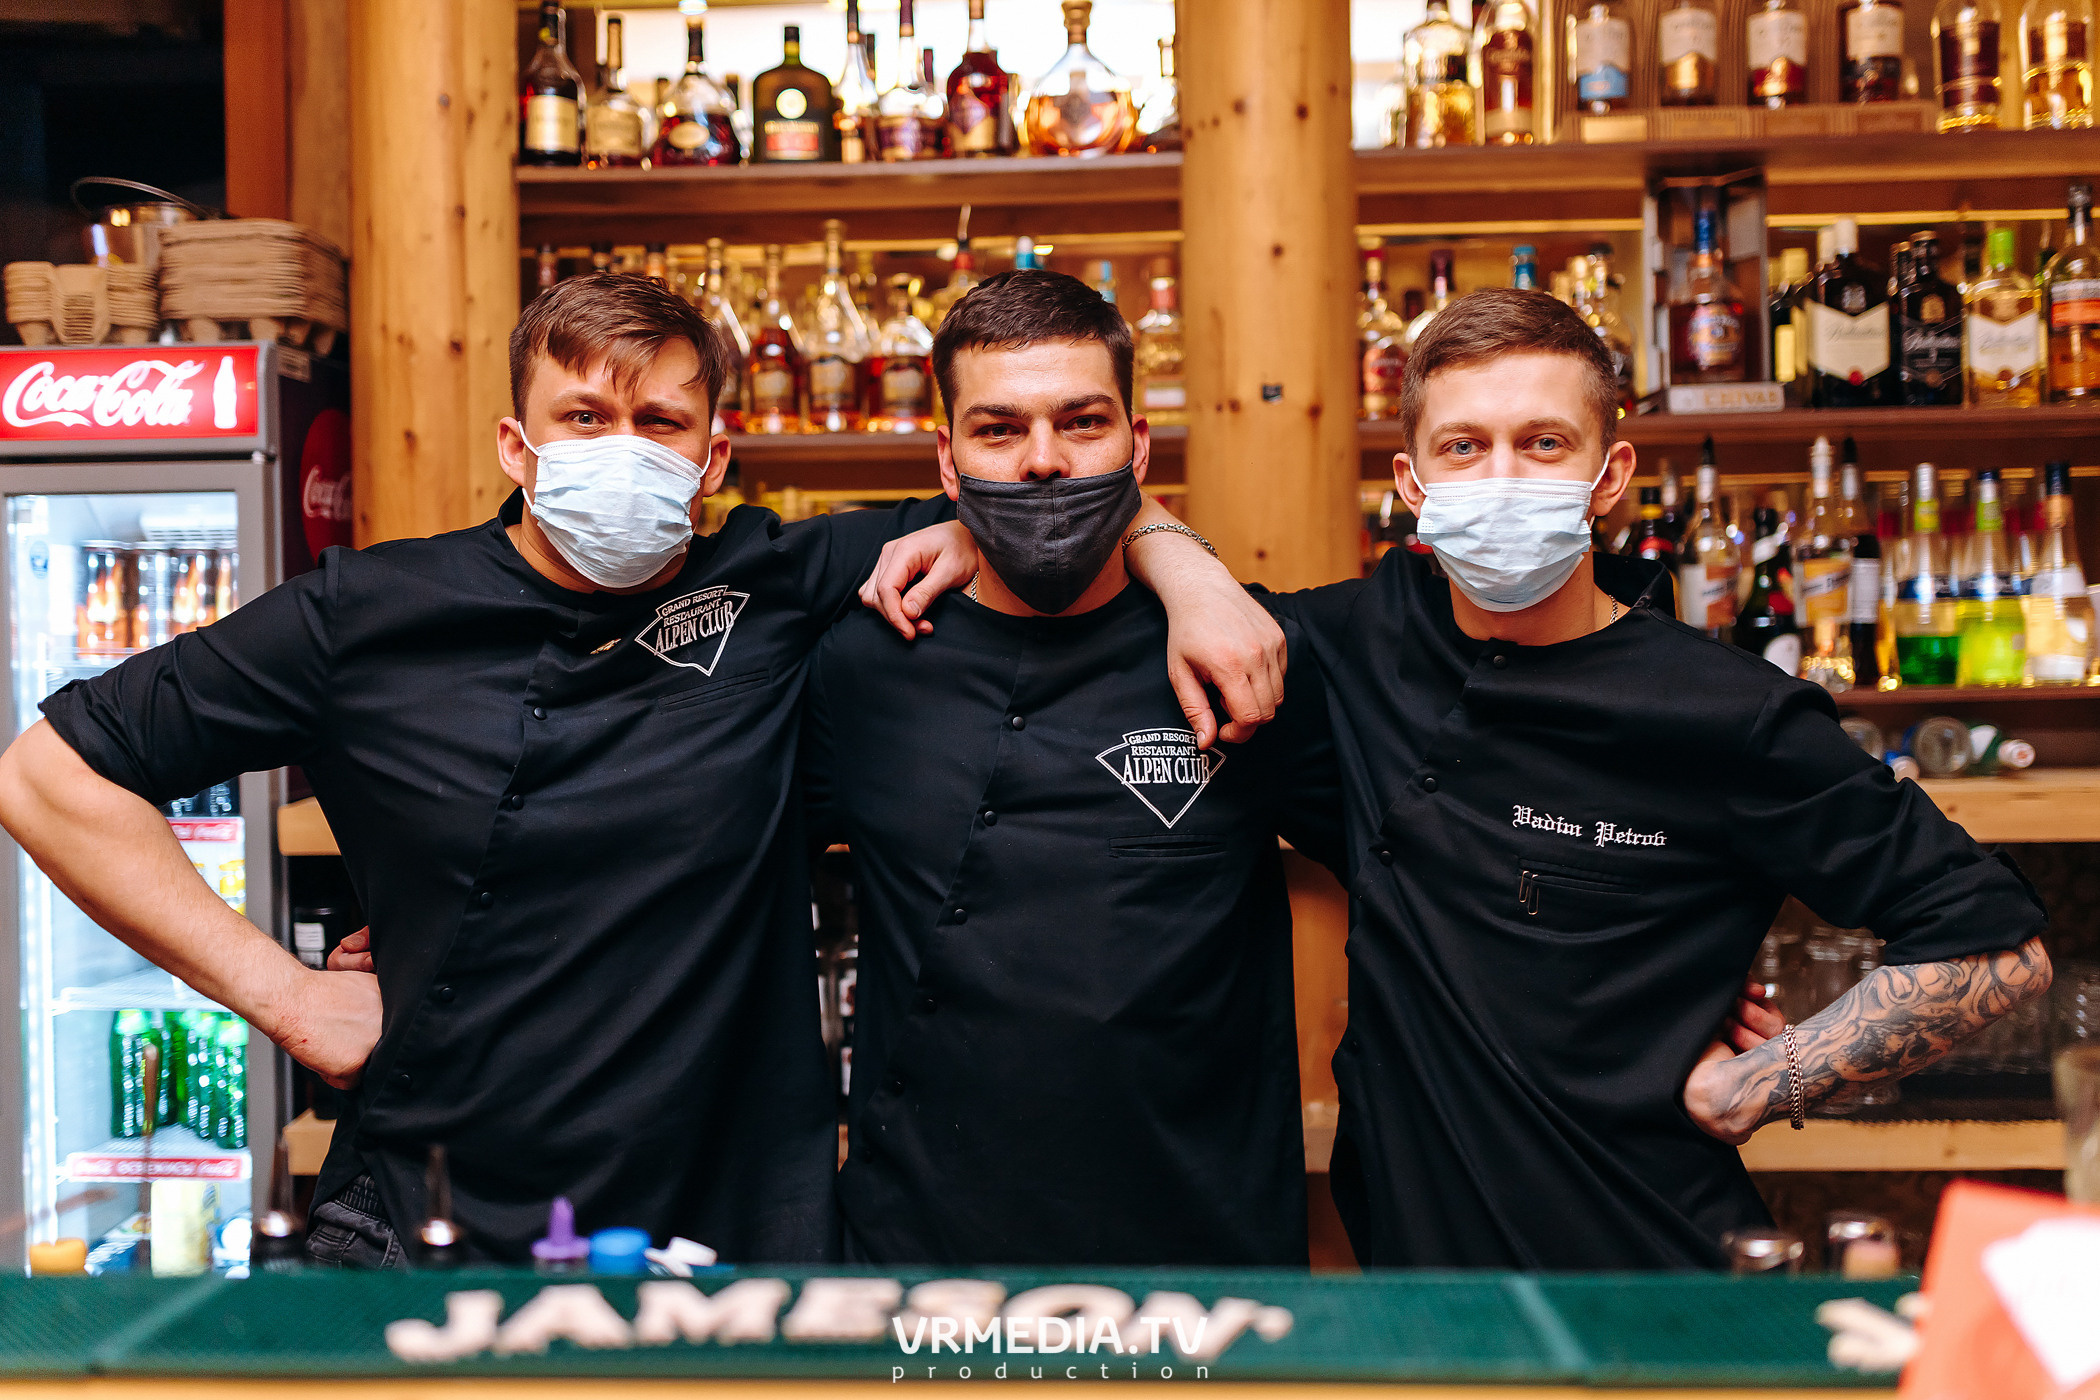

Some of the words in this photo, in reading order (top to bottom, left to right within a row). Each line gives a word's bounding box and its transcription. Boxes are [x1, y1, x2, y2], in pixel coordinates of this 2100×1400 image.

[2, 359, 206, 428] Coca-Cola
[661, 598, 692, 617] GRAND
[692, 589, 725, 604] RESORT
[663, 598, 722, 628] RESTAURANT
[654, 618, 698, 656] ALPEN
[699, 600, 735, 638] CLUB
[1128, 733, 1161, 745] GRAND
[1162, 732, 1197, 745] RESORT
[1131, 745, 1197, 756] RESTAURANT
[1121, 754, 1173, 785] ALPEN
[1174, 754, 1211, 784] CLUB
[1512, 804, 1583, 838] Vadim
[1594, 821, 1668, 848] Petrov
